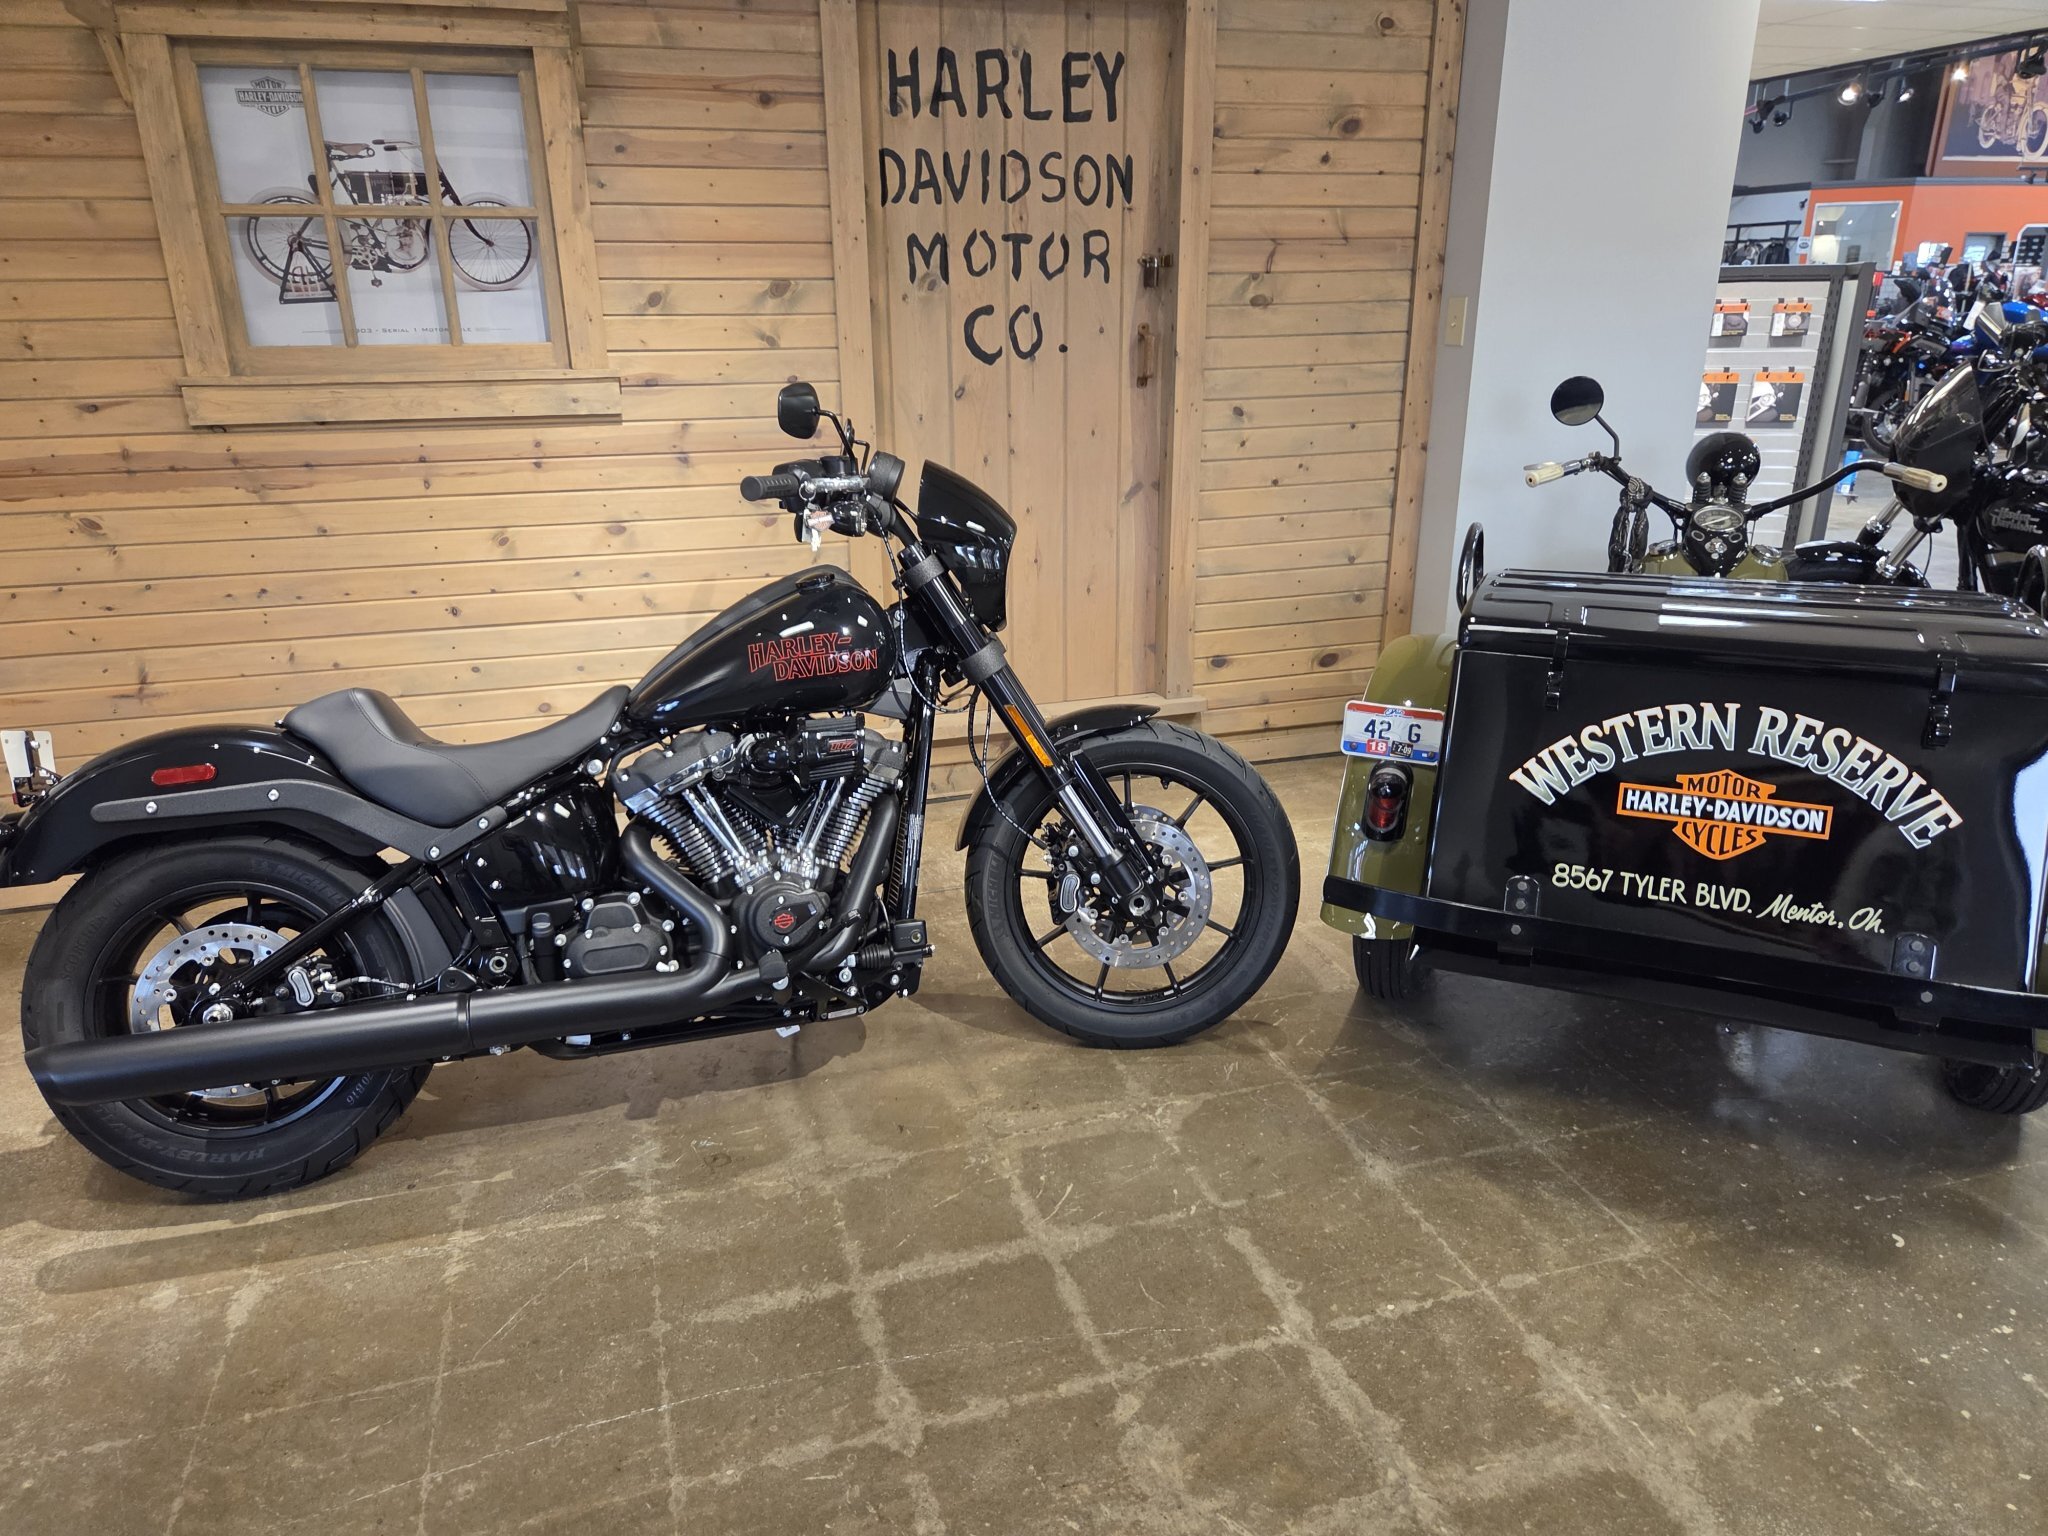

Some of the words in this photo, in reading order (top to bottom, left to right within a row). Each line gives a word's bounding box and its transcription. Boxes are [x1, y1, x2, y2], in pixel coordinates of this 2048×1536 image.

[255, 79, 282, 89] MOTOR
[888, 46, 1125, 123] HARLEY
[879, 148, 1133, 209] DAVIDSON
[906, 228, 1110, 285] MOTOR
[963, 304, 1069, 366] CO.
[747, 632, 852, 673] HARLEY-
[772, 648, 878, 681] DAVIDSON
[1363, 718, 1392, 740] 42
[1407, 723, 1422, 744] G
[1369, 740, 1387, 752] 18
[1509, 702, 1741, 806] WESTERN
[1748, 706, 1964, 850] RESERVE
[1688, 773, 1762, 799] MOTOR
[1625, 791, 1825, 833] HARLEY-DAVIDSON
[1681, 820, 1758, 855] CYCLES
[1551, 863, 1613, 893] 8567
[1620, 871, 1687, 905] TYLER
[1696, 882, 1753, 914] BLVD.
[1756, 893, 1844, 929] Mentor,
[1849, 906, 1886, 935] Oh.
